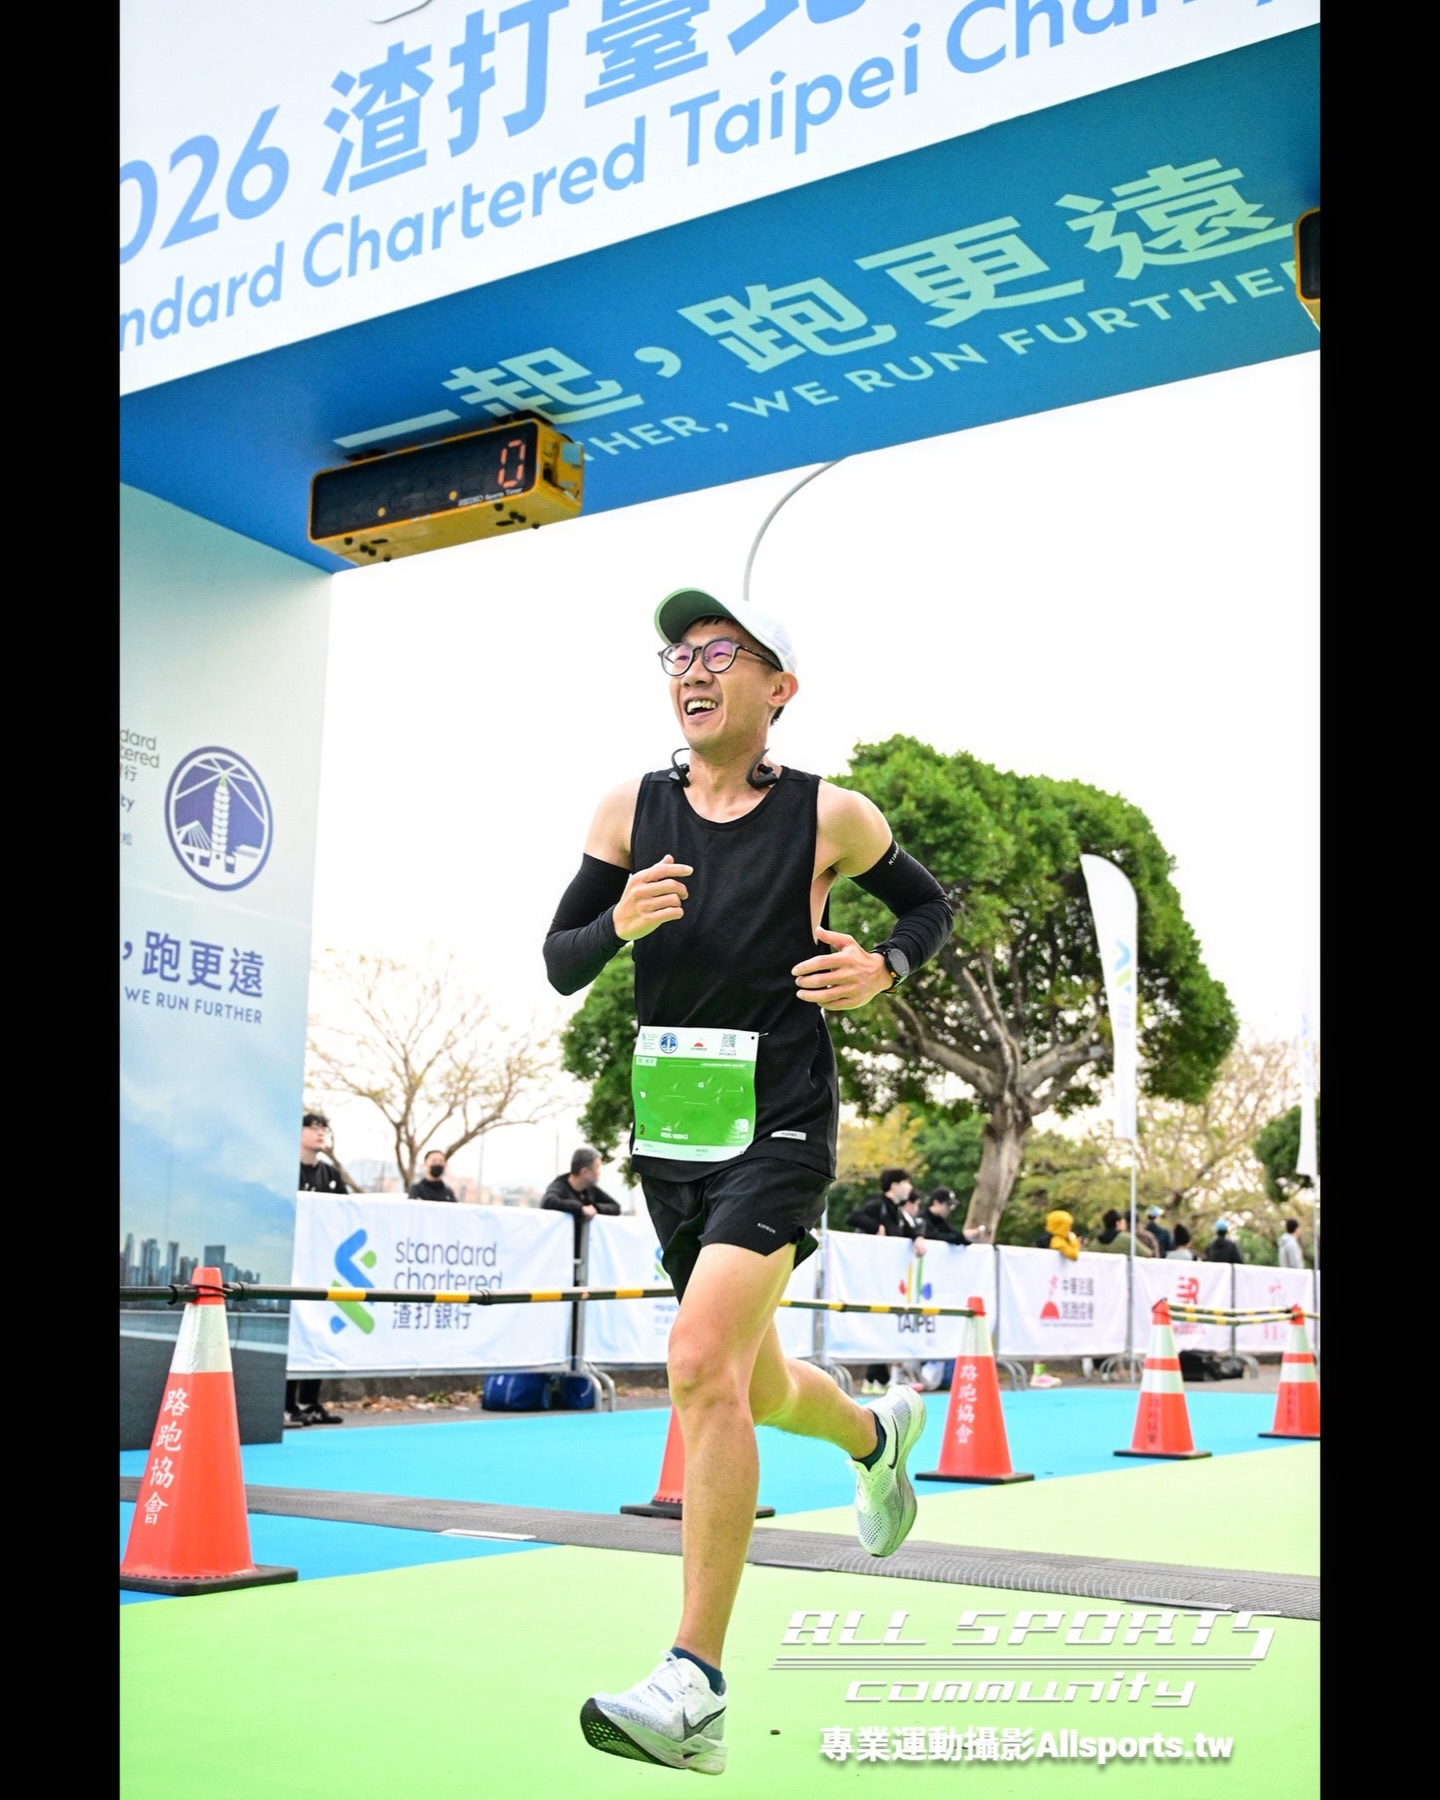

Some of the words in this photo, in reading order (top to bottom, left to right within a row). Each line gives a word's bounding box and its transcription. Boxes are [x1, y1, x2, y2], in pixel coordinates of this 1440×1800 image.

[303, 115, 647, 288] Chartered
[670, 22, 922, 167] Taipei
[576, 416, 728, 461] HER,
[727, 381, 840, 421] WE
[844, 343, 988, 393] RUN
[498, 440, 526, 488] 0
[124, 986, 150, 1005] WE
[157, 992, 189, 1011] RUN
[195, 999, 263, 1024] FURTHER
[395, 1238, 498, 1267] standard
[394, 1270, 502, 1291] chartered
[392, 1301, 472, 1331] 渣打銀行
[956, 1363, 979, 1444] 路跑協會
[143, 1388, 190, 1525] 路跑協會
